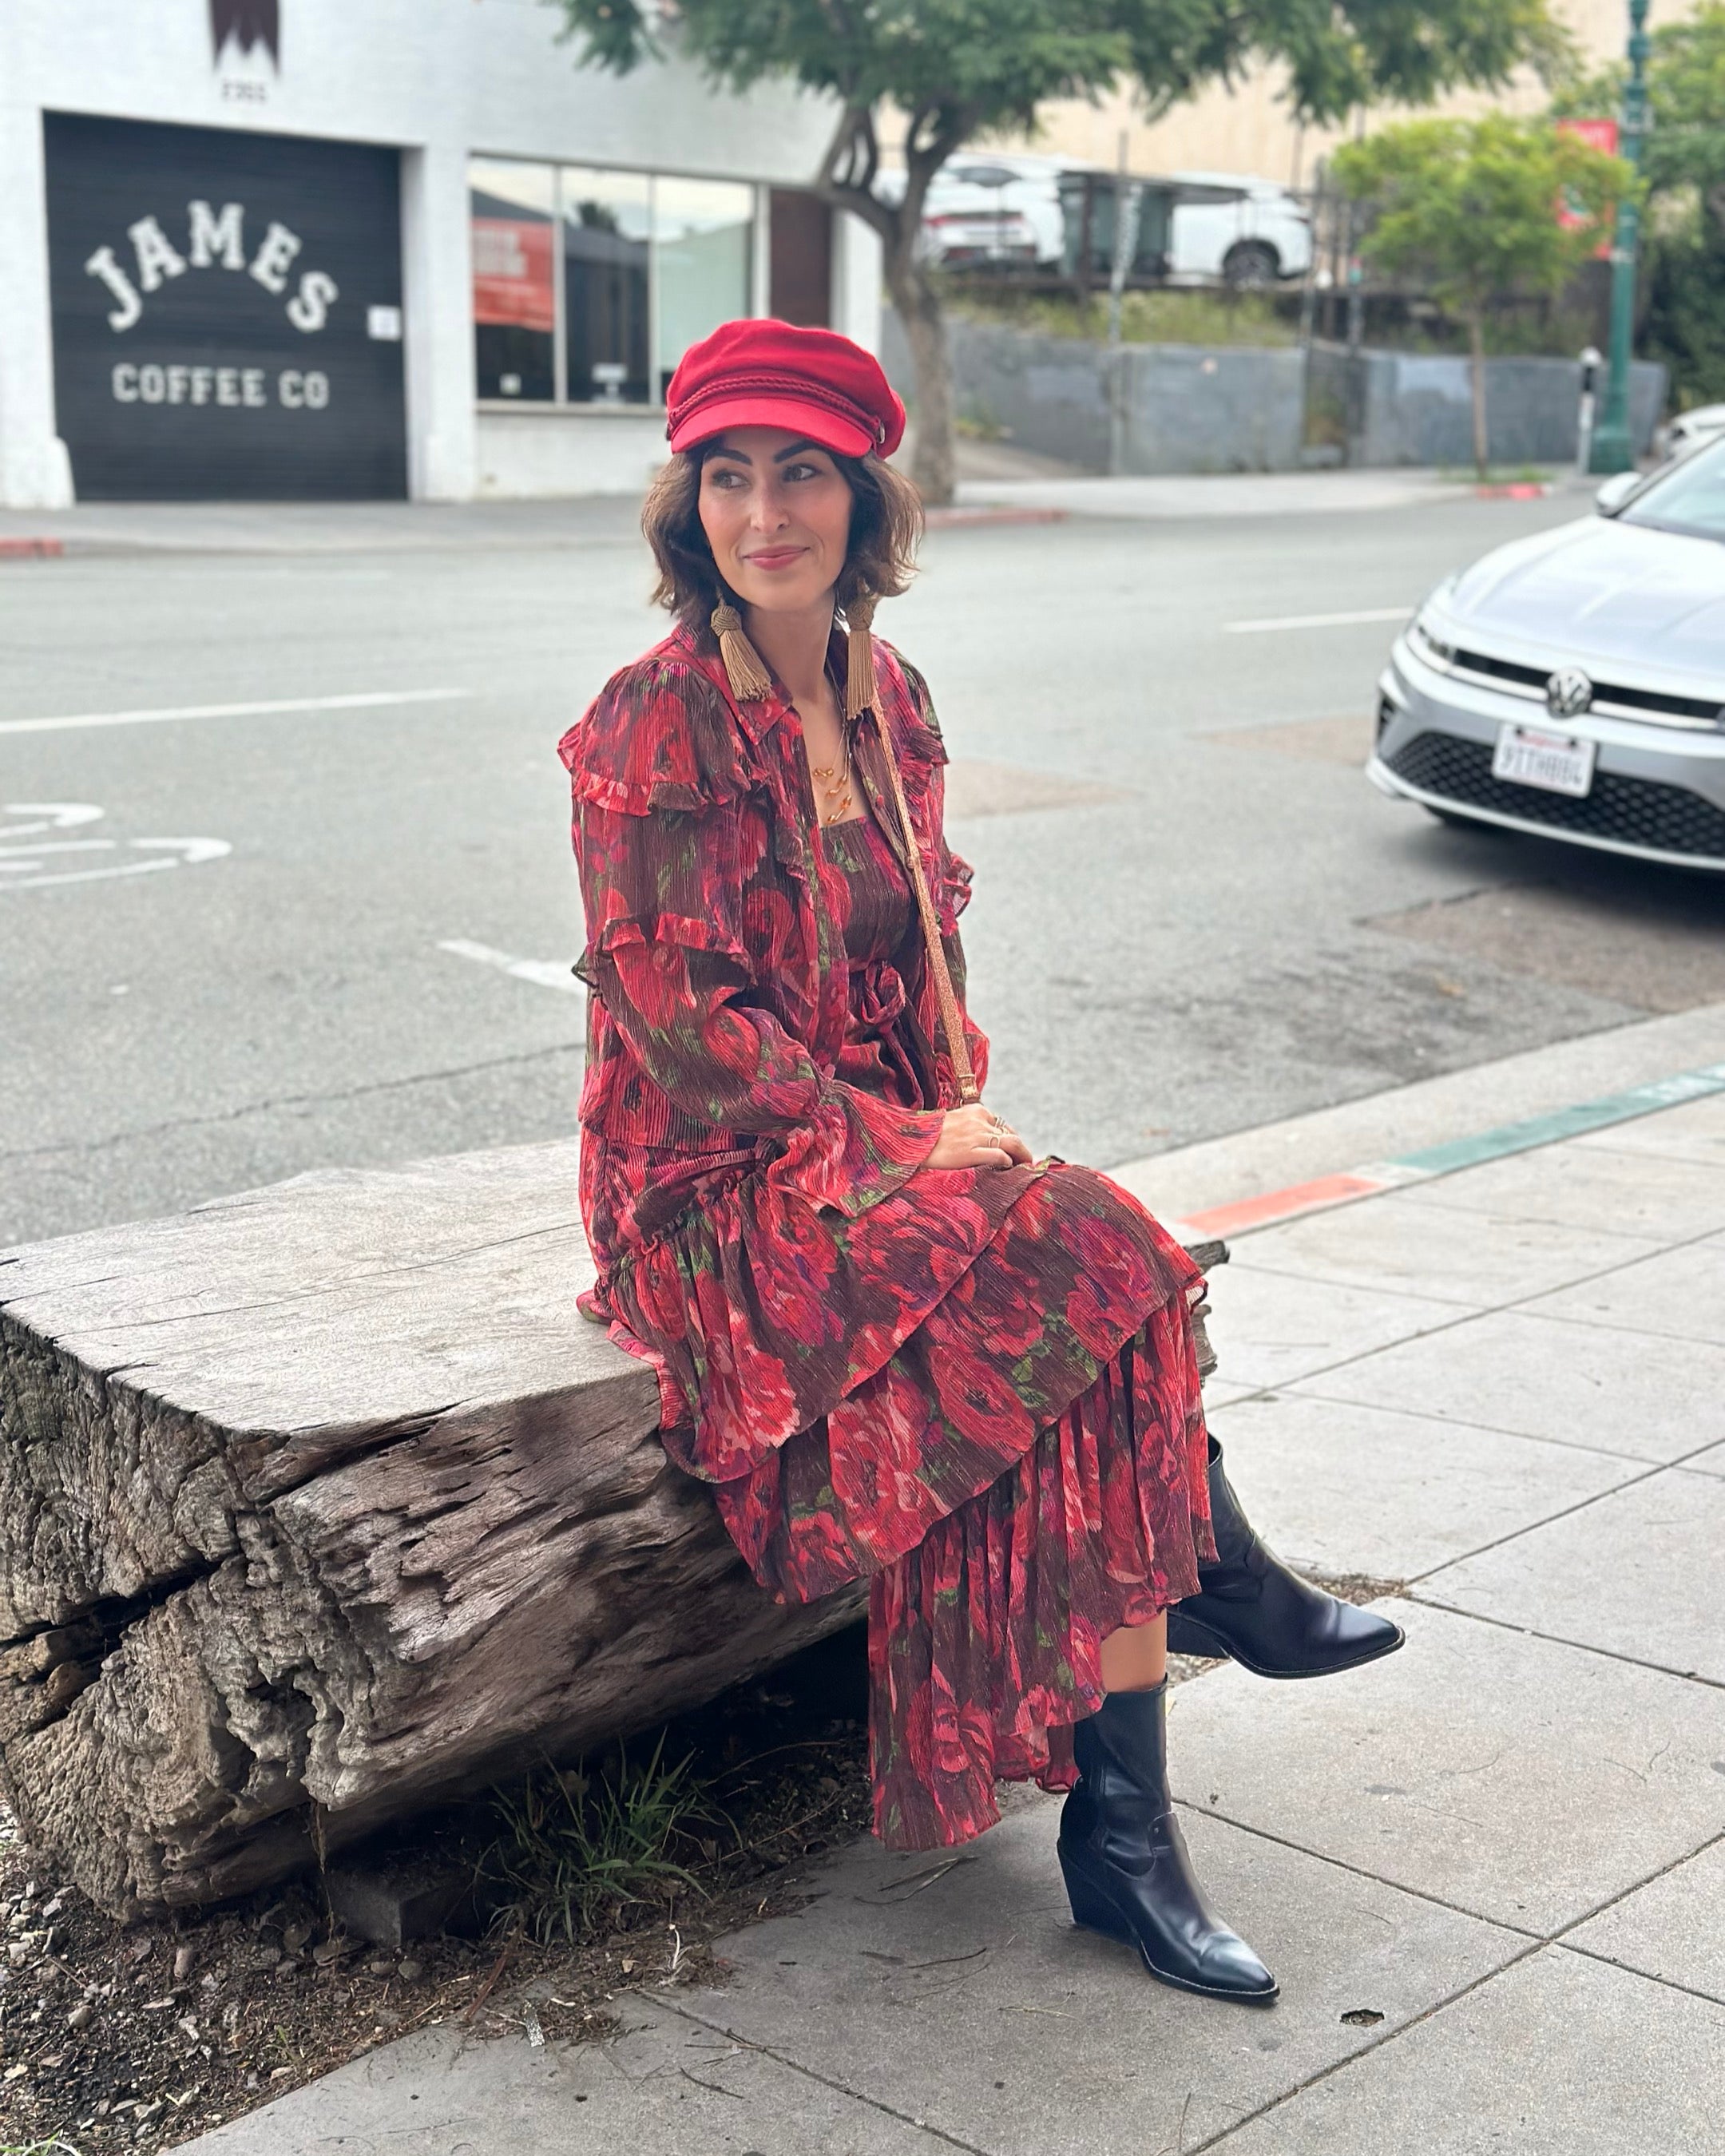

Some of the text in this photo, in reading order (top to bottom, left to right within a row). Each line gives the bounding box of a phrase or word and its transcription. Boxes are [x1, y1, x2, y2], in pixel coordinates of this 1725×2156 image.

[85, 200, 339, 332] JAMES
[113, 363, 330, 410] COFFEE CO
